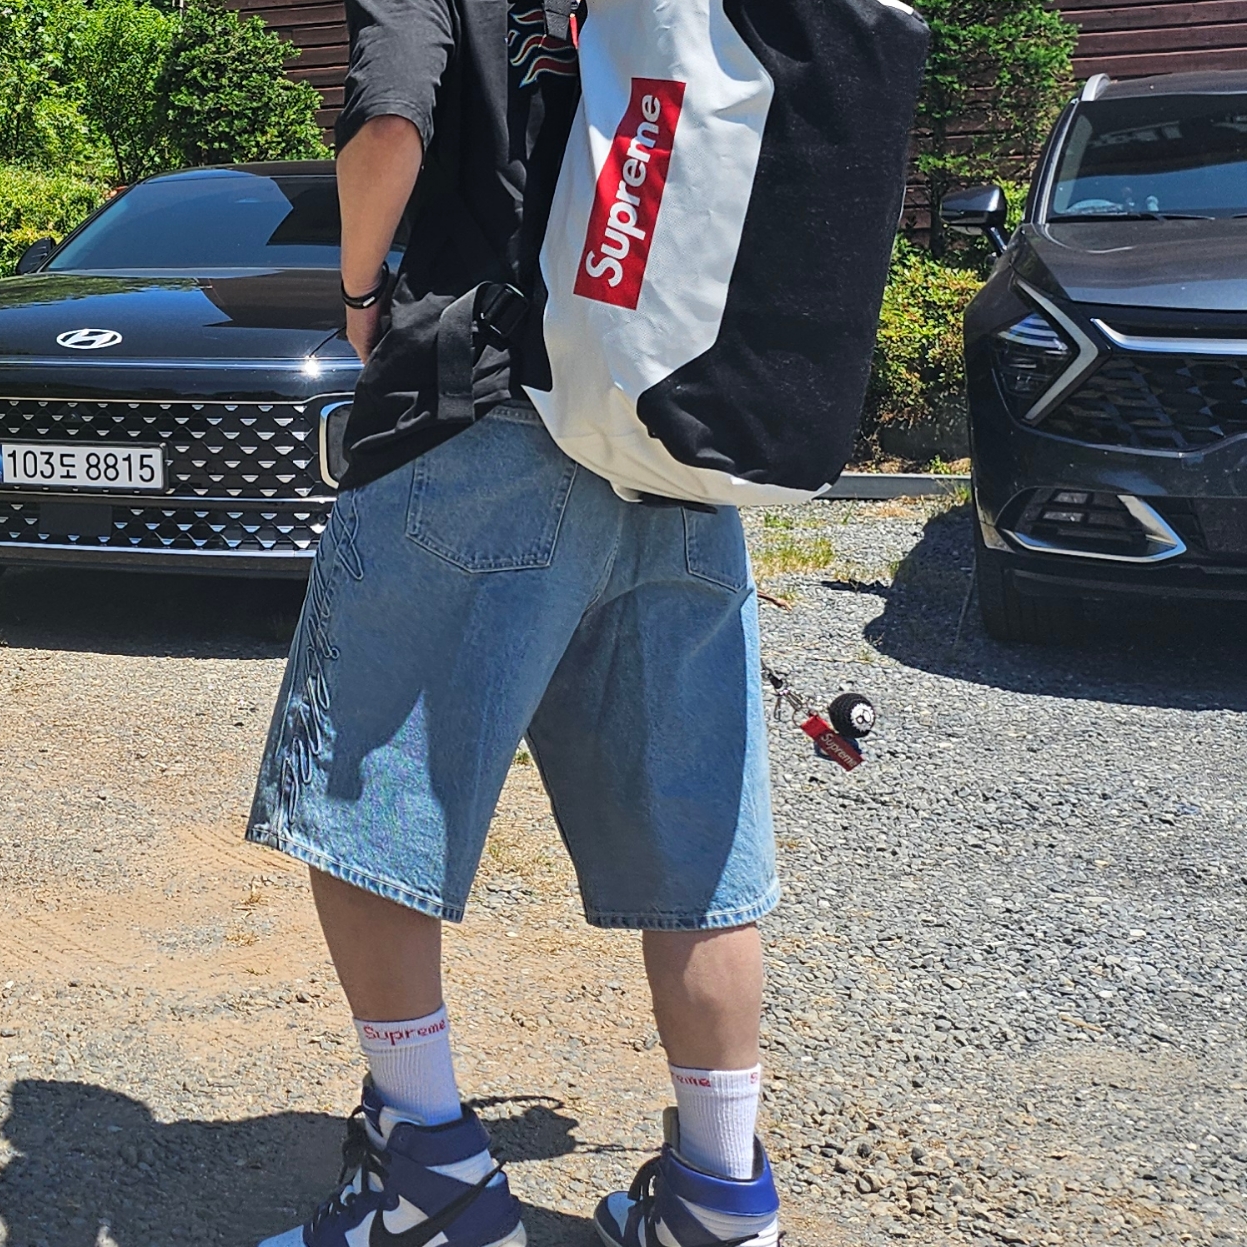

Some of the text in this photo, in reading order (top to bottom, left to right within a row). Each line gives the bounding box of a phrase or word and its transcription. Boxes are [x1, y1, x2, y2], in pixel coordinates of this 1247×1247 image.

[585, 94, 661, 288] Supreme
[7, 449, 155, 483] 103도 8815
[820, 733, 858, 767] Supreme
[363, 1019, 446, 1046] Supreme
